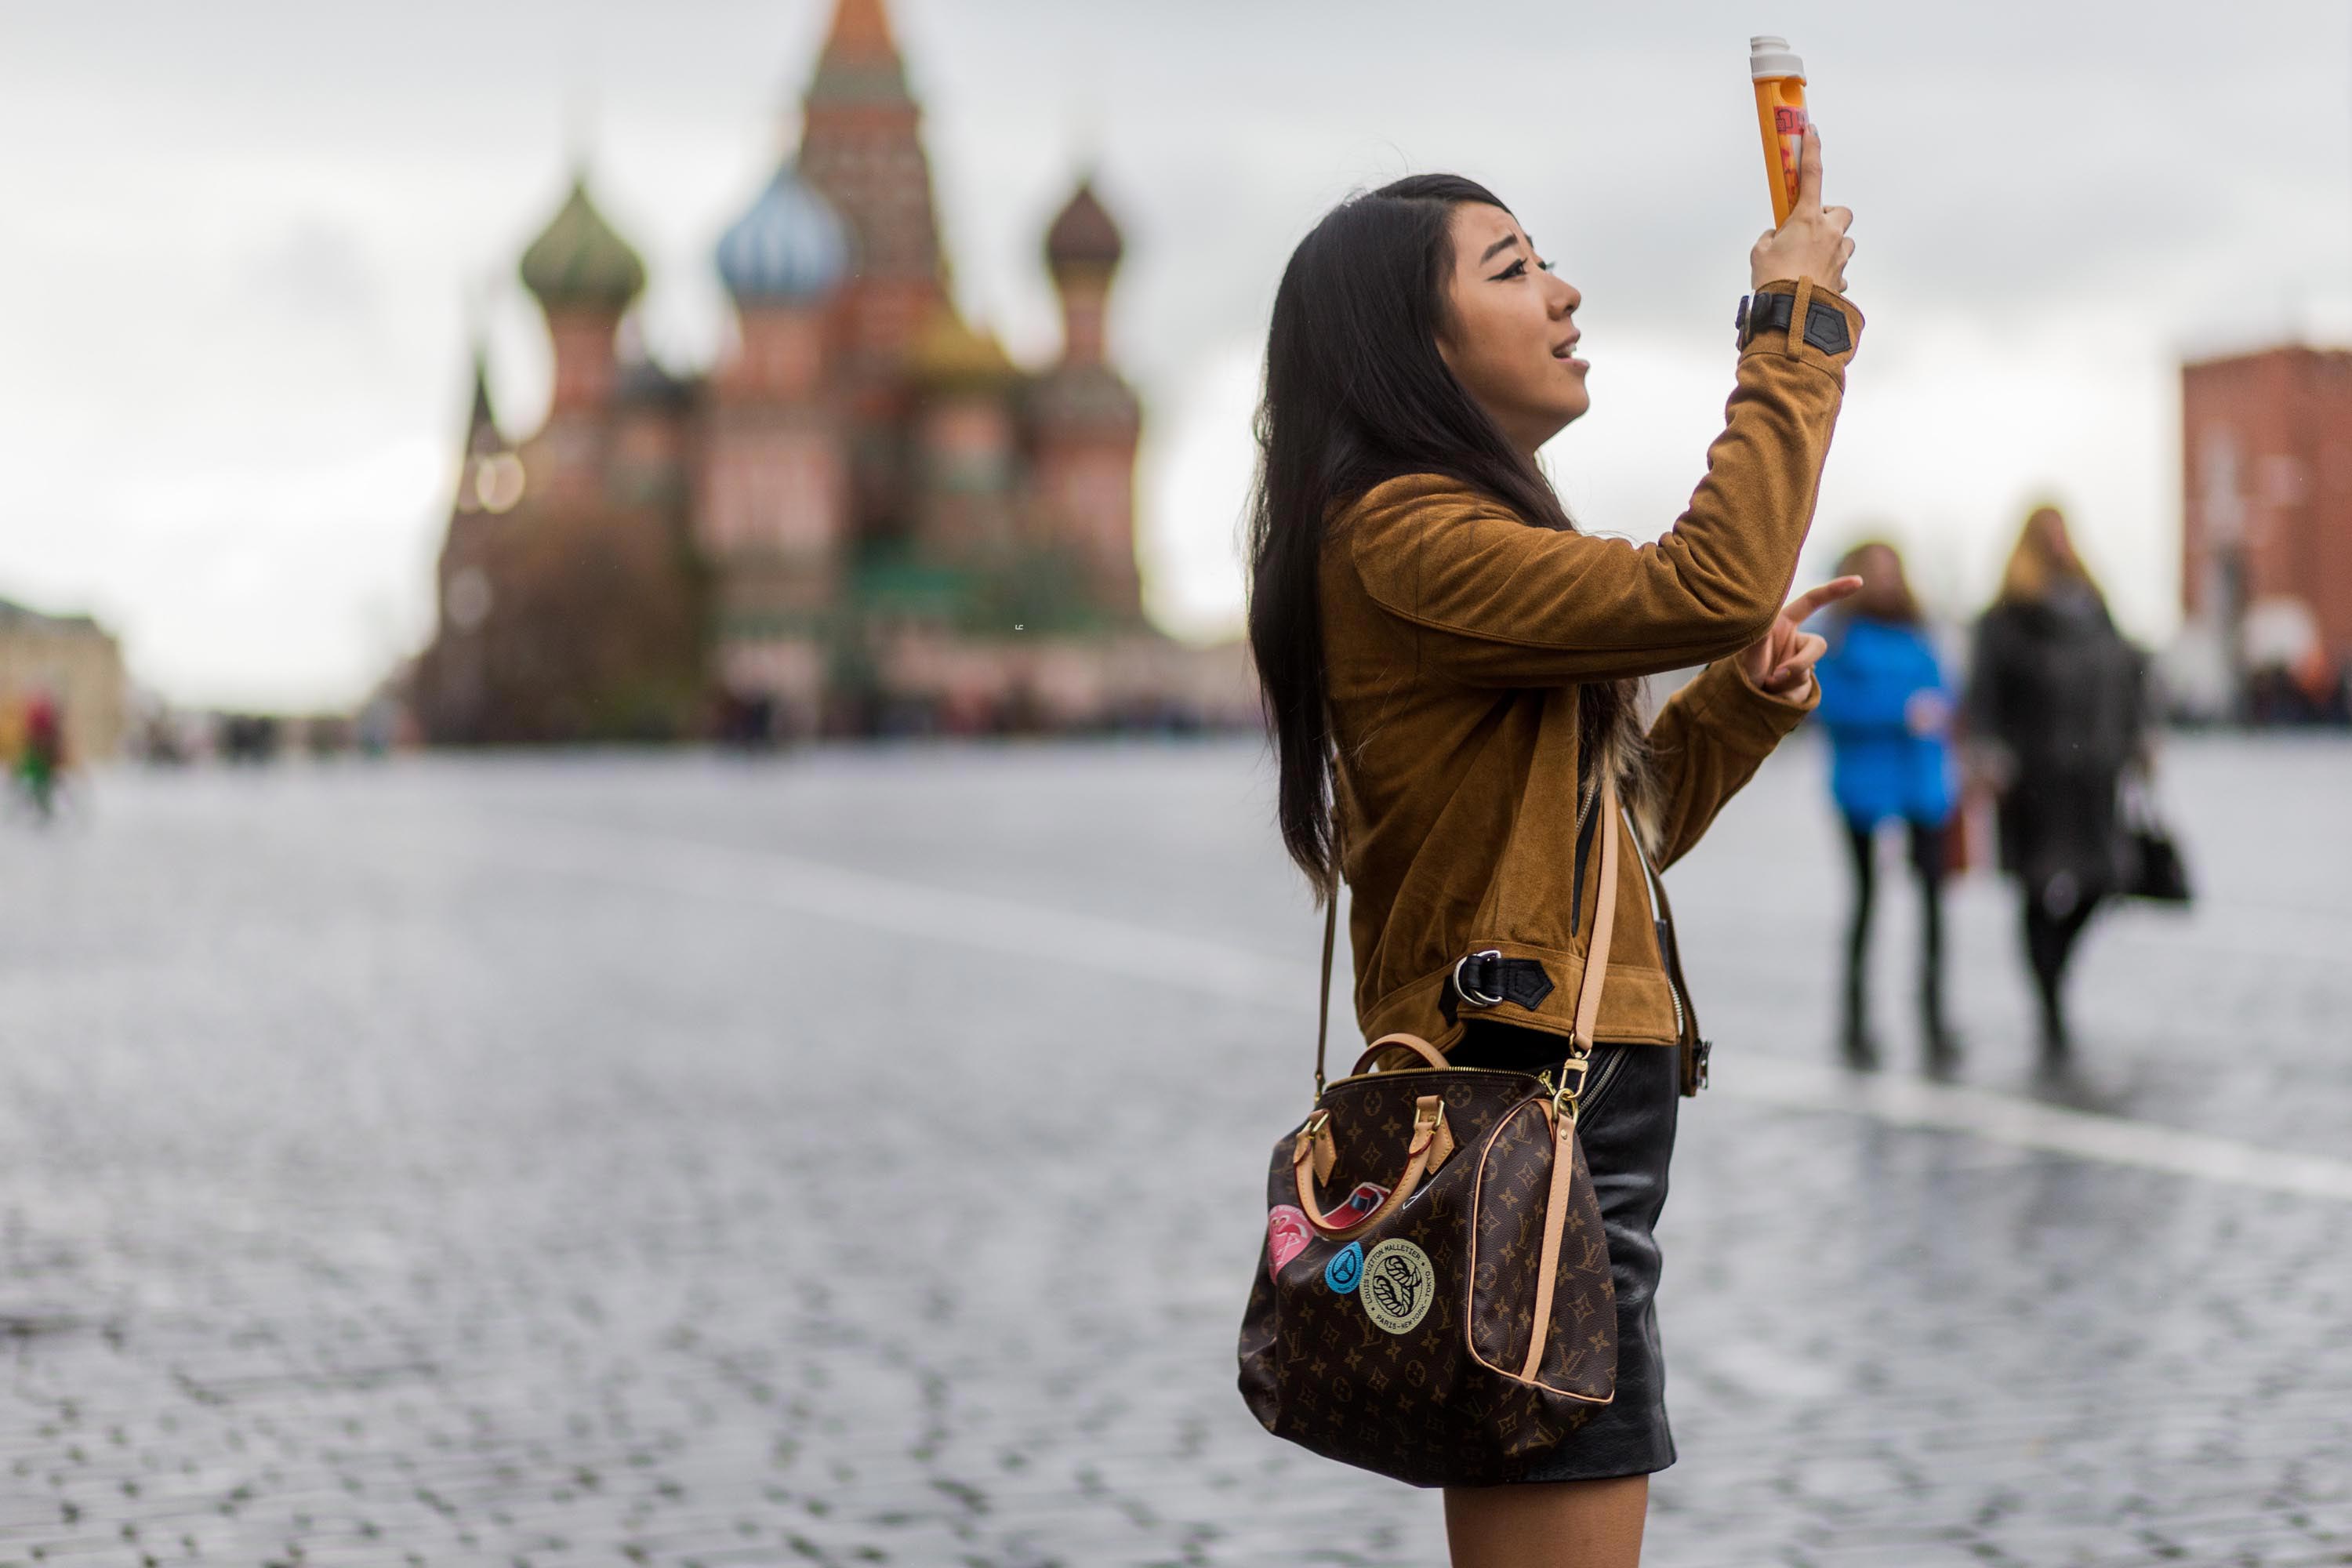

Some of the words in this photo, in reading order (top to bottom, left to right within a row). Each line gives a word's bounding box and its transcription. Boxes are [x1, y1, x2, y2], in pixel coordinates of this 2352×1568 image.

[1365, 1248, 1384, 1276] VUITTON
[1385, 1244, 1421, 1261] MALLETIER
[1363, 1278, 1372, 1304] LOUIS
